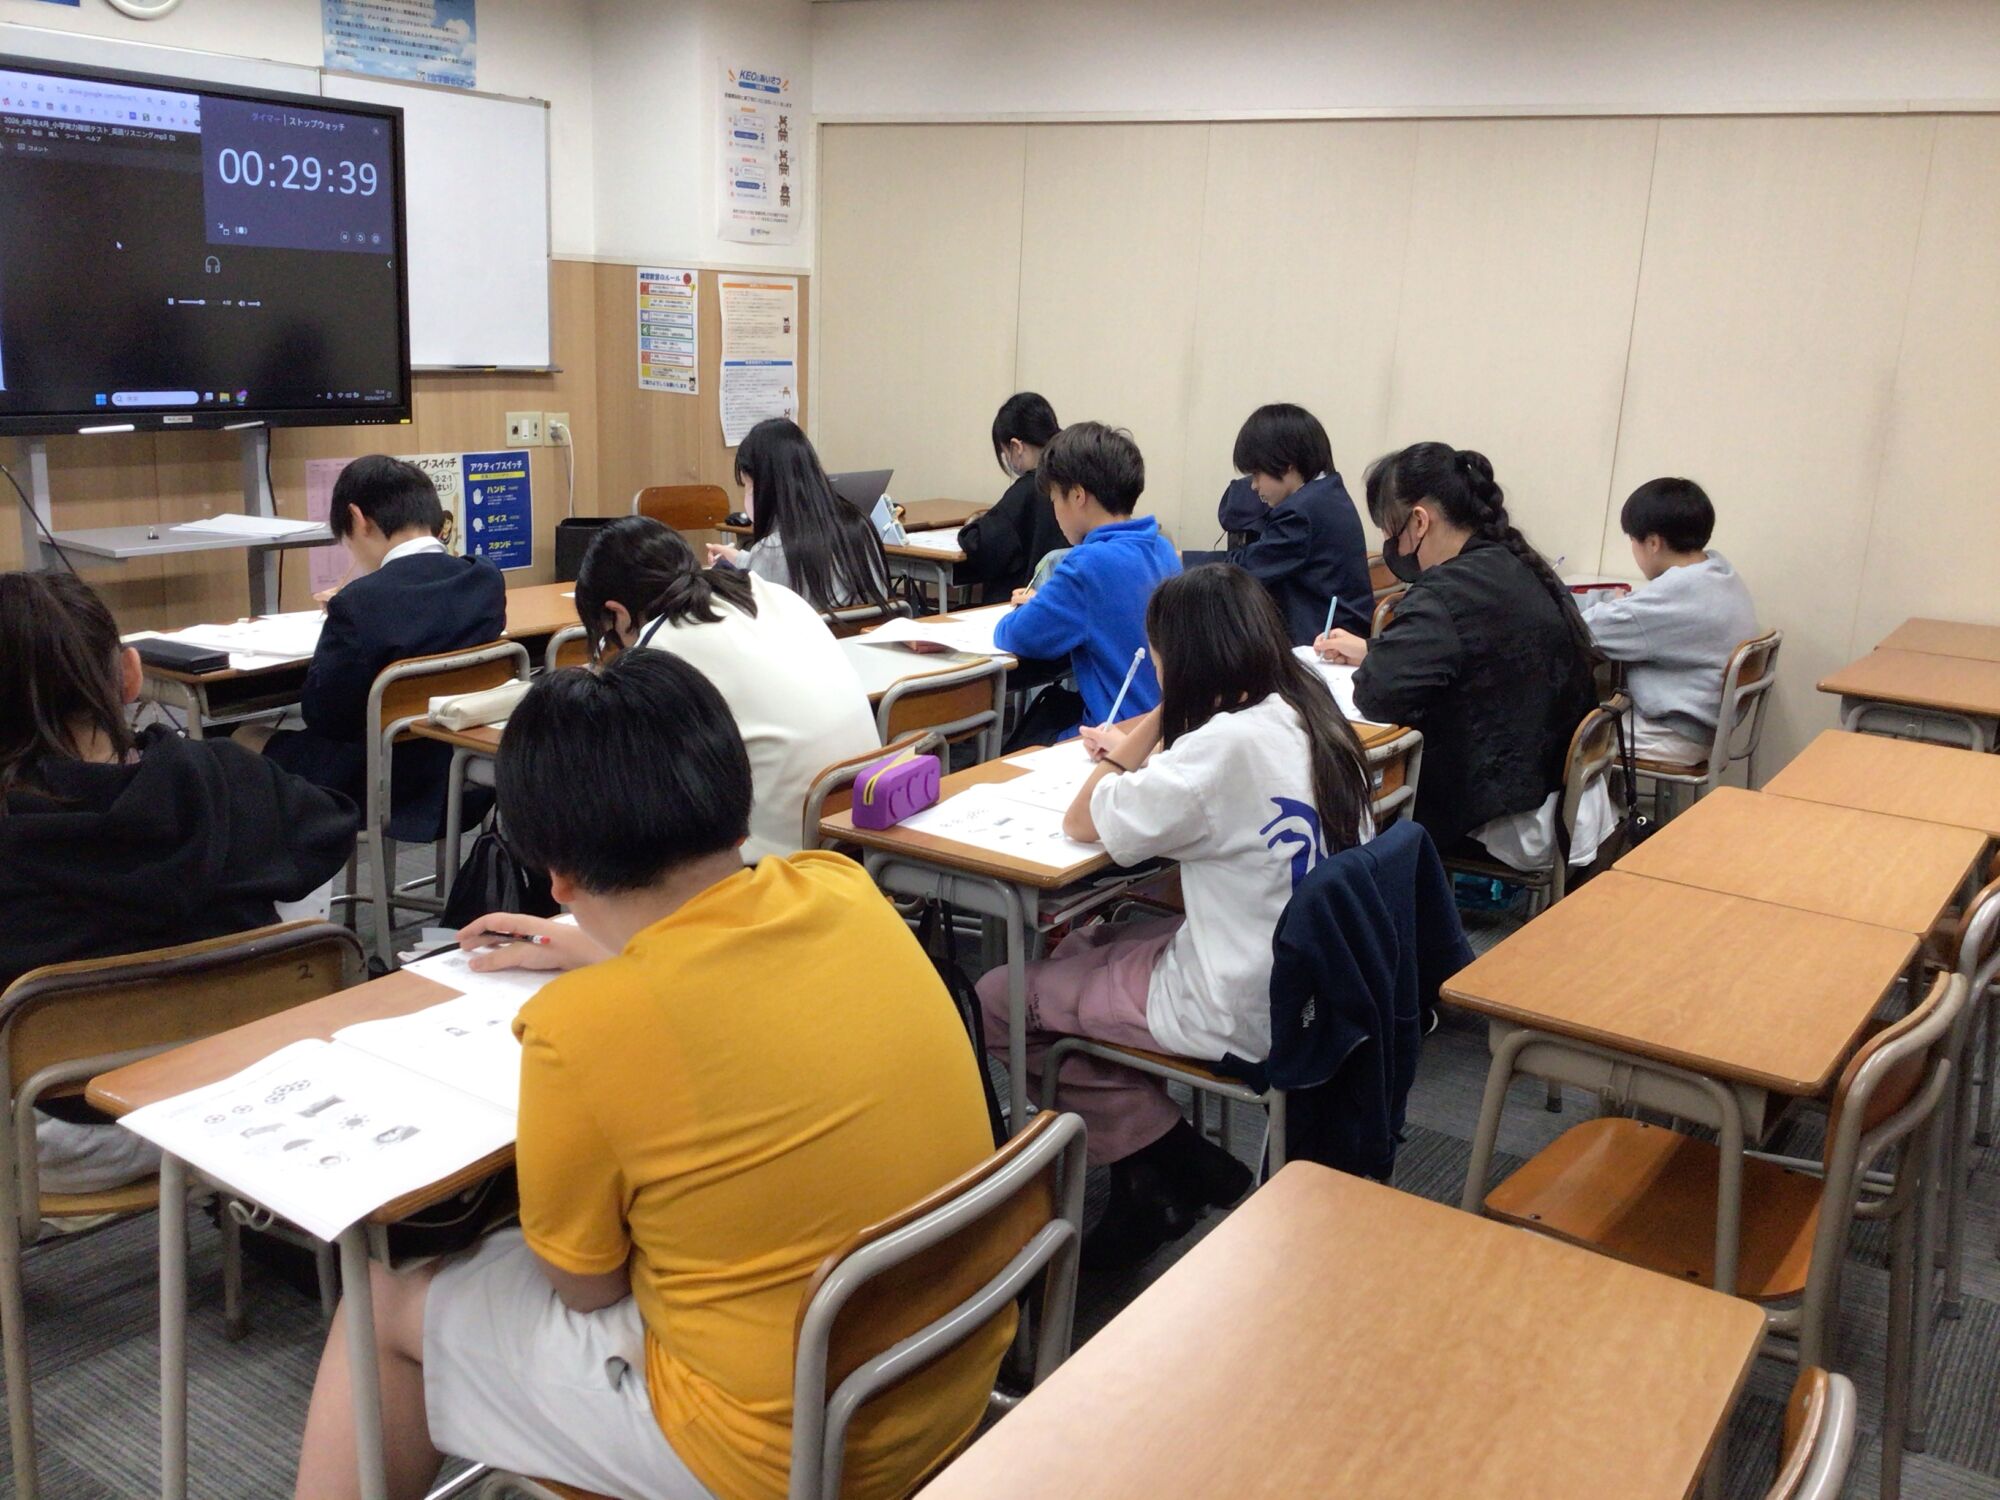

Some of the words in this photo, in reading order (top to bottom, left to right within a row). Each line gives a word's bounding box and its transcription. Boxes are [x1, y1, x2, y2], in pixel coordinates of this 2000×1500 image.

[289, 116, 345, 131] ストップウォッチ
[218, 148, 378, 196] 00:29:39
[486, 485, 507, 494] ハンド
